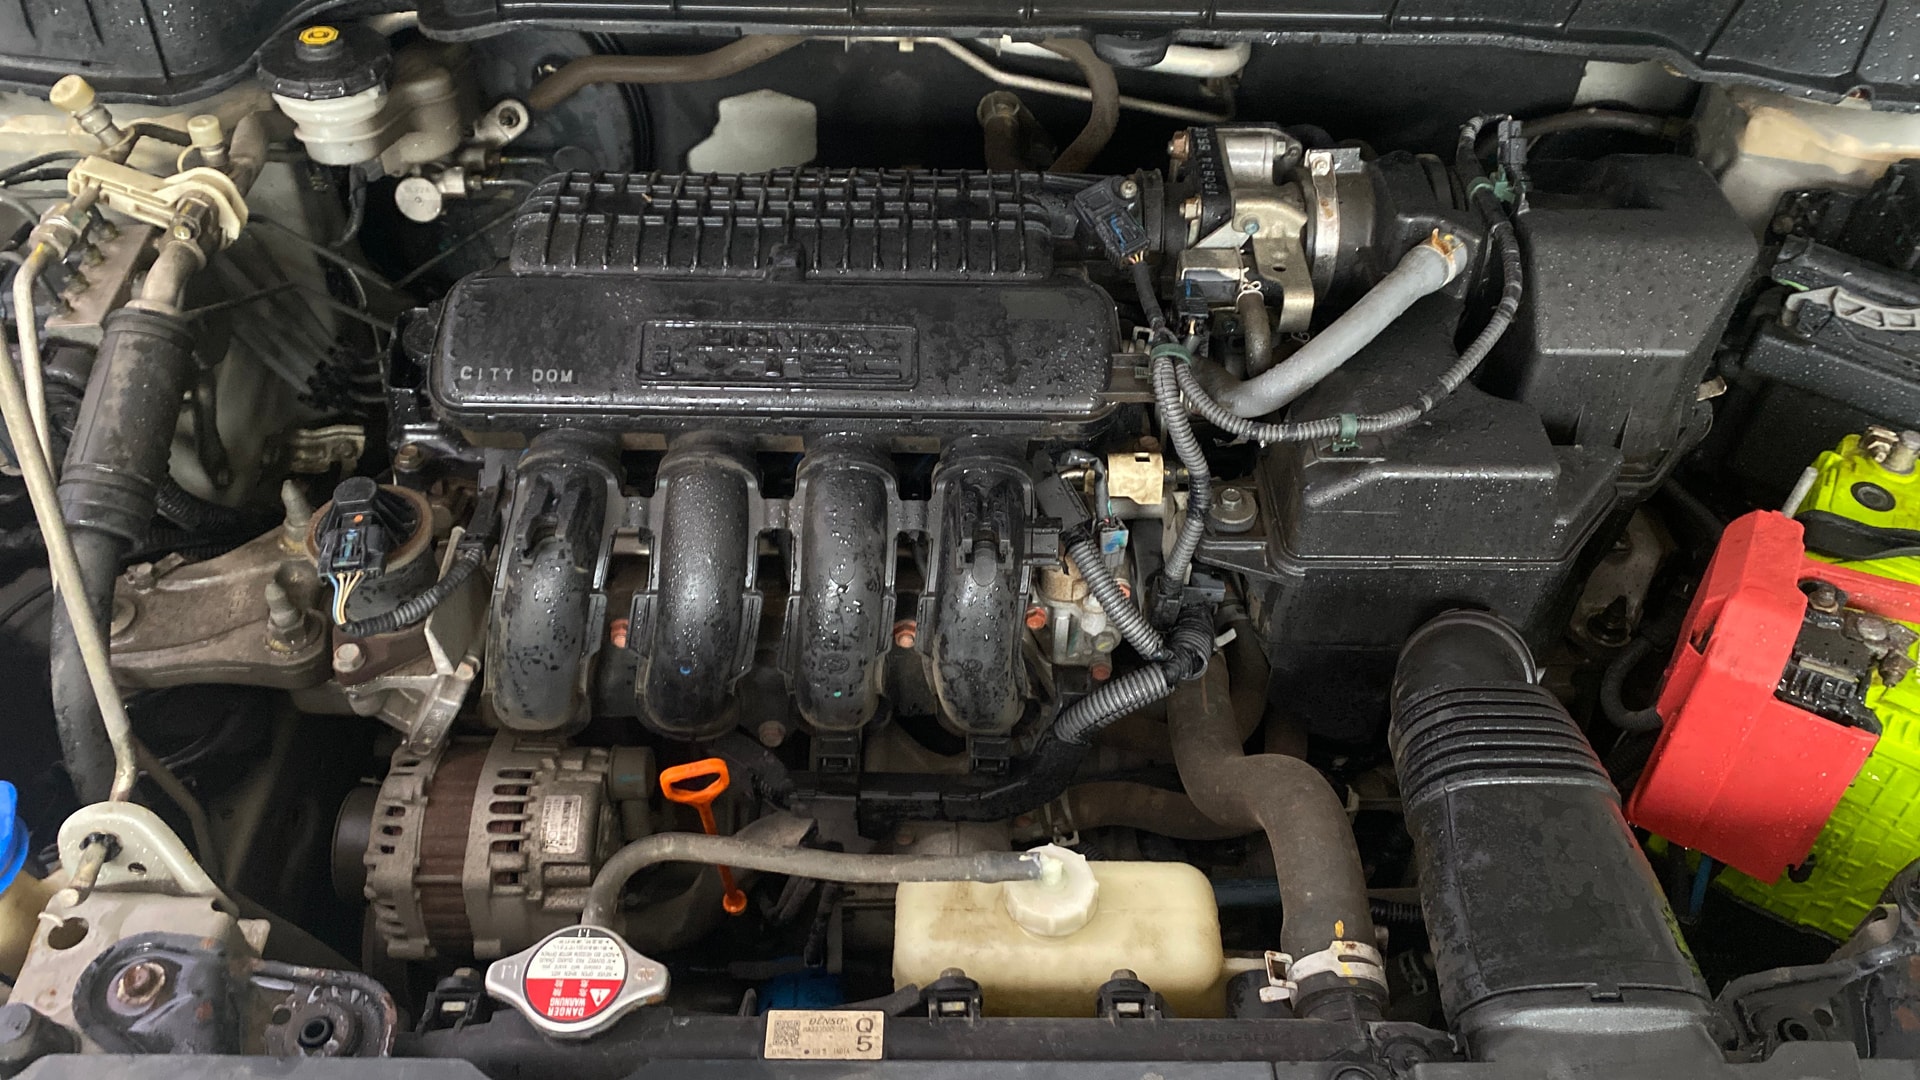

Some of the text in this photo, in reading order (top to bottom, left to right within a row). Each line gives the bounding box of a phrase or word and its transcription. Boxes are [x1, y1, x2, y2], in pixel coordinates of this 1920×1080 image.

[460, 366, 573, 383] CITY DOM
[549, 997, 586, 1006] WARNUNG
[547, 1007, 584, 1016] DANGER
[809, 1018, 844, 1026] DENSO
[856, 1018, 874, 1033] Q
[856, 1036, 872, 1052] 5
